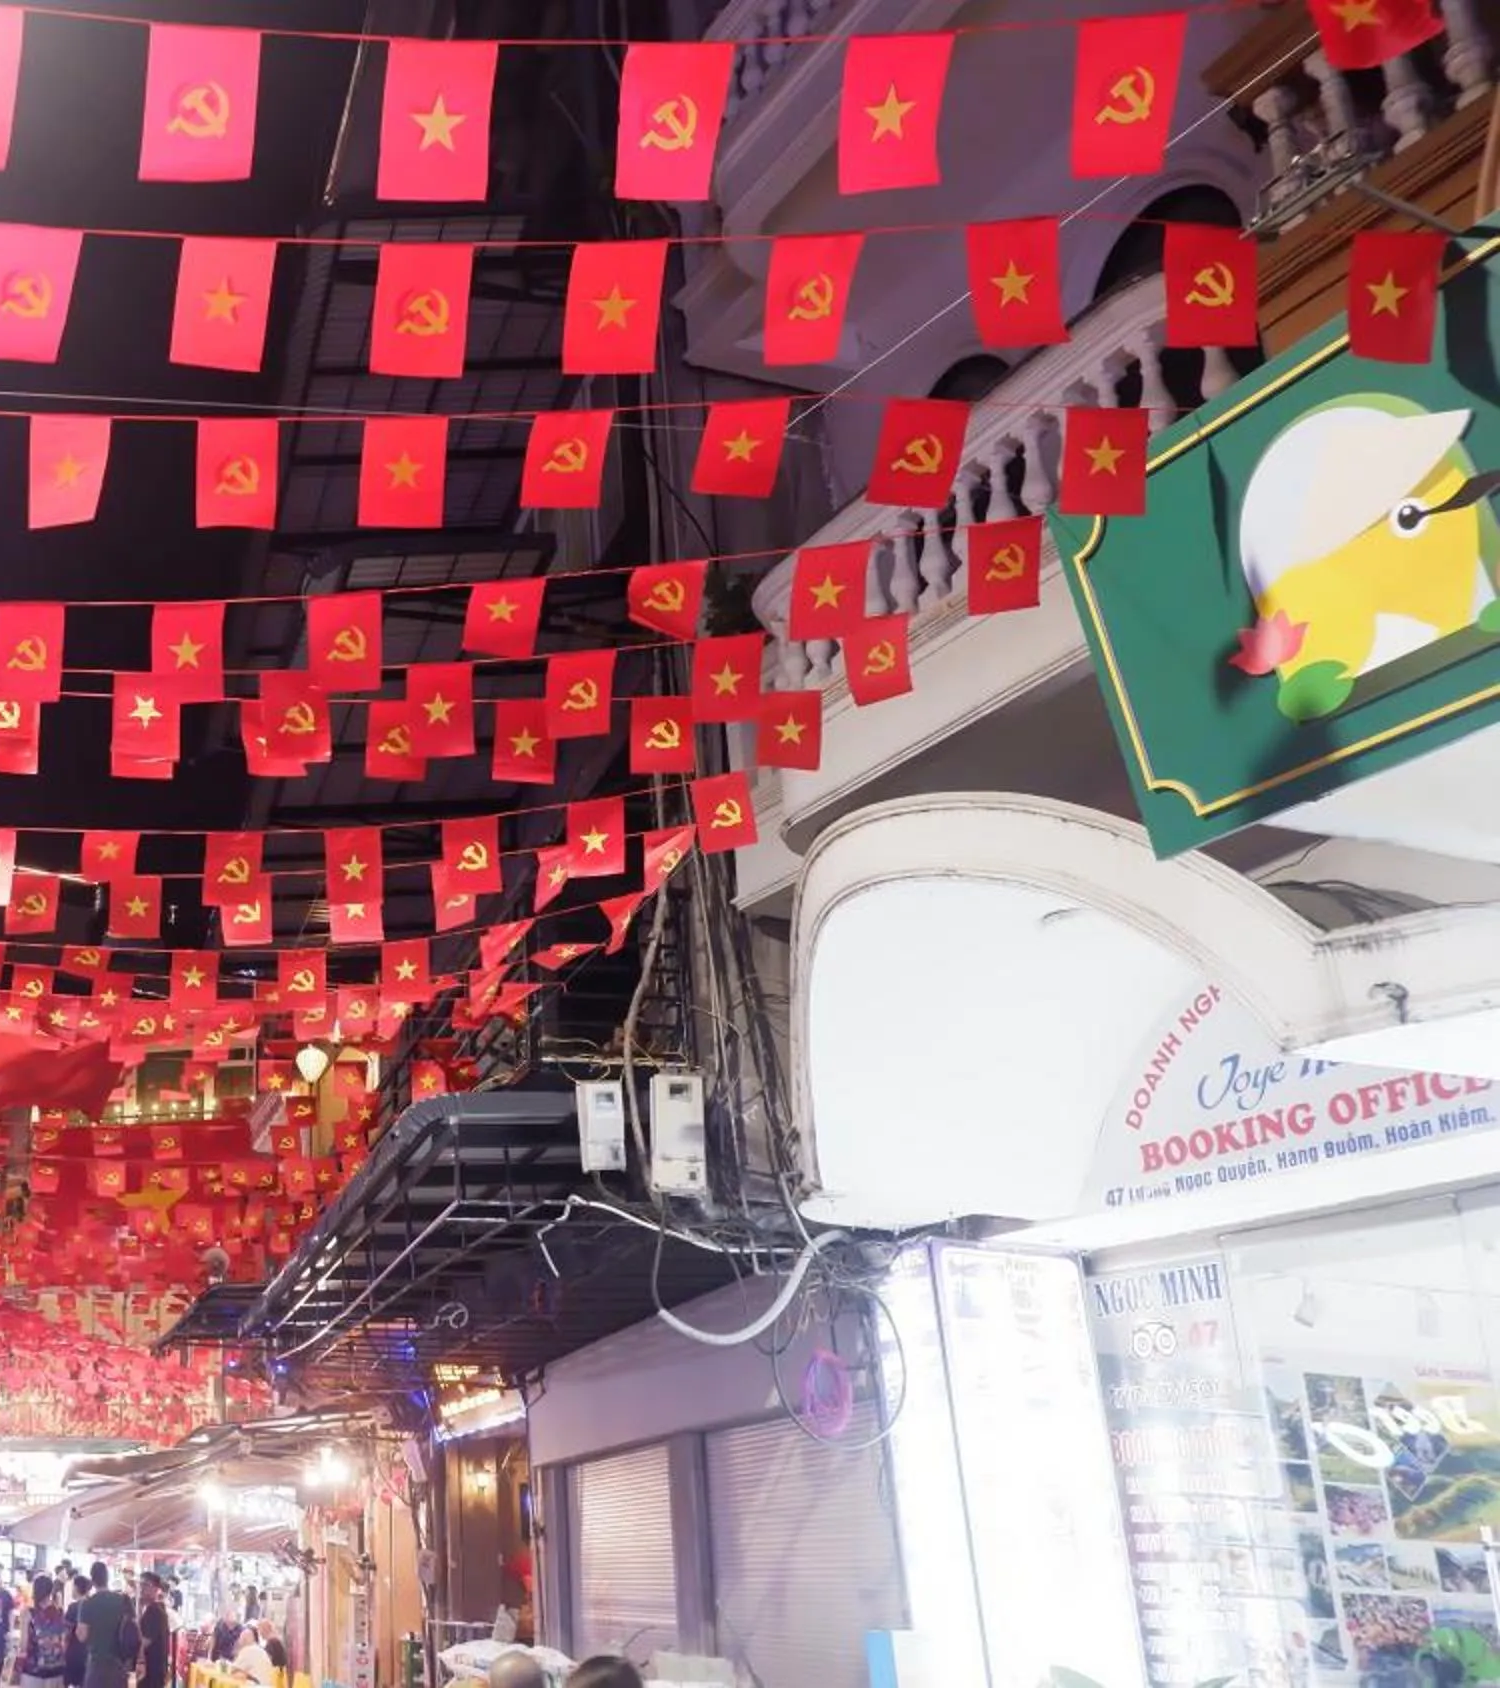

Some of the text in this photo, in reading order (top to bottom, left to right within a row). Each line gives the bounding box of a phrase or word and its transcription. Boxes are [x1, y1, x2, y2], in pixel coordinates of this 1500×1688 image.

[1125, 1032, 1182, 1130] DOANH
[1140, 1103, 1316, 1173] BOOKING
[1158, 1263, 1223, 1306] MINH
